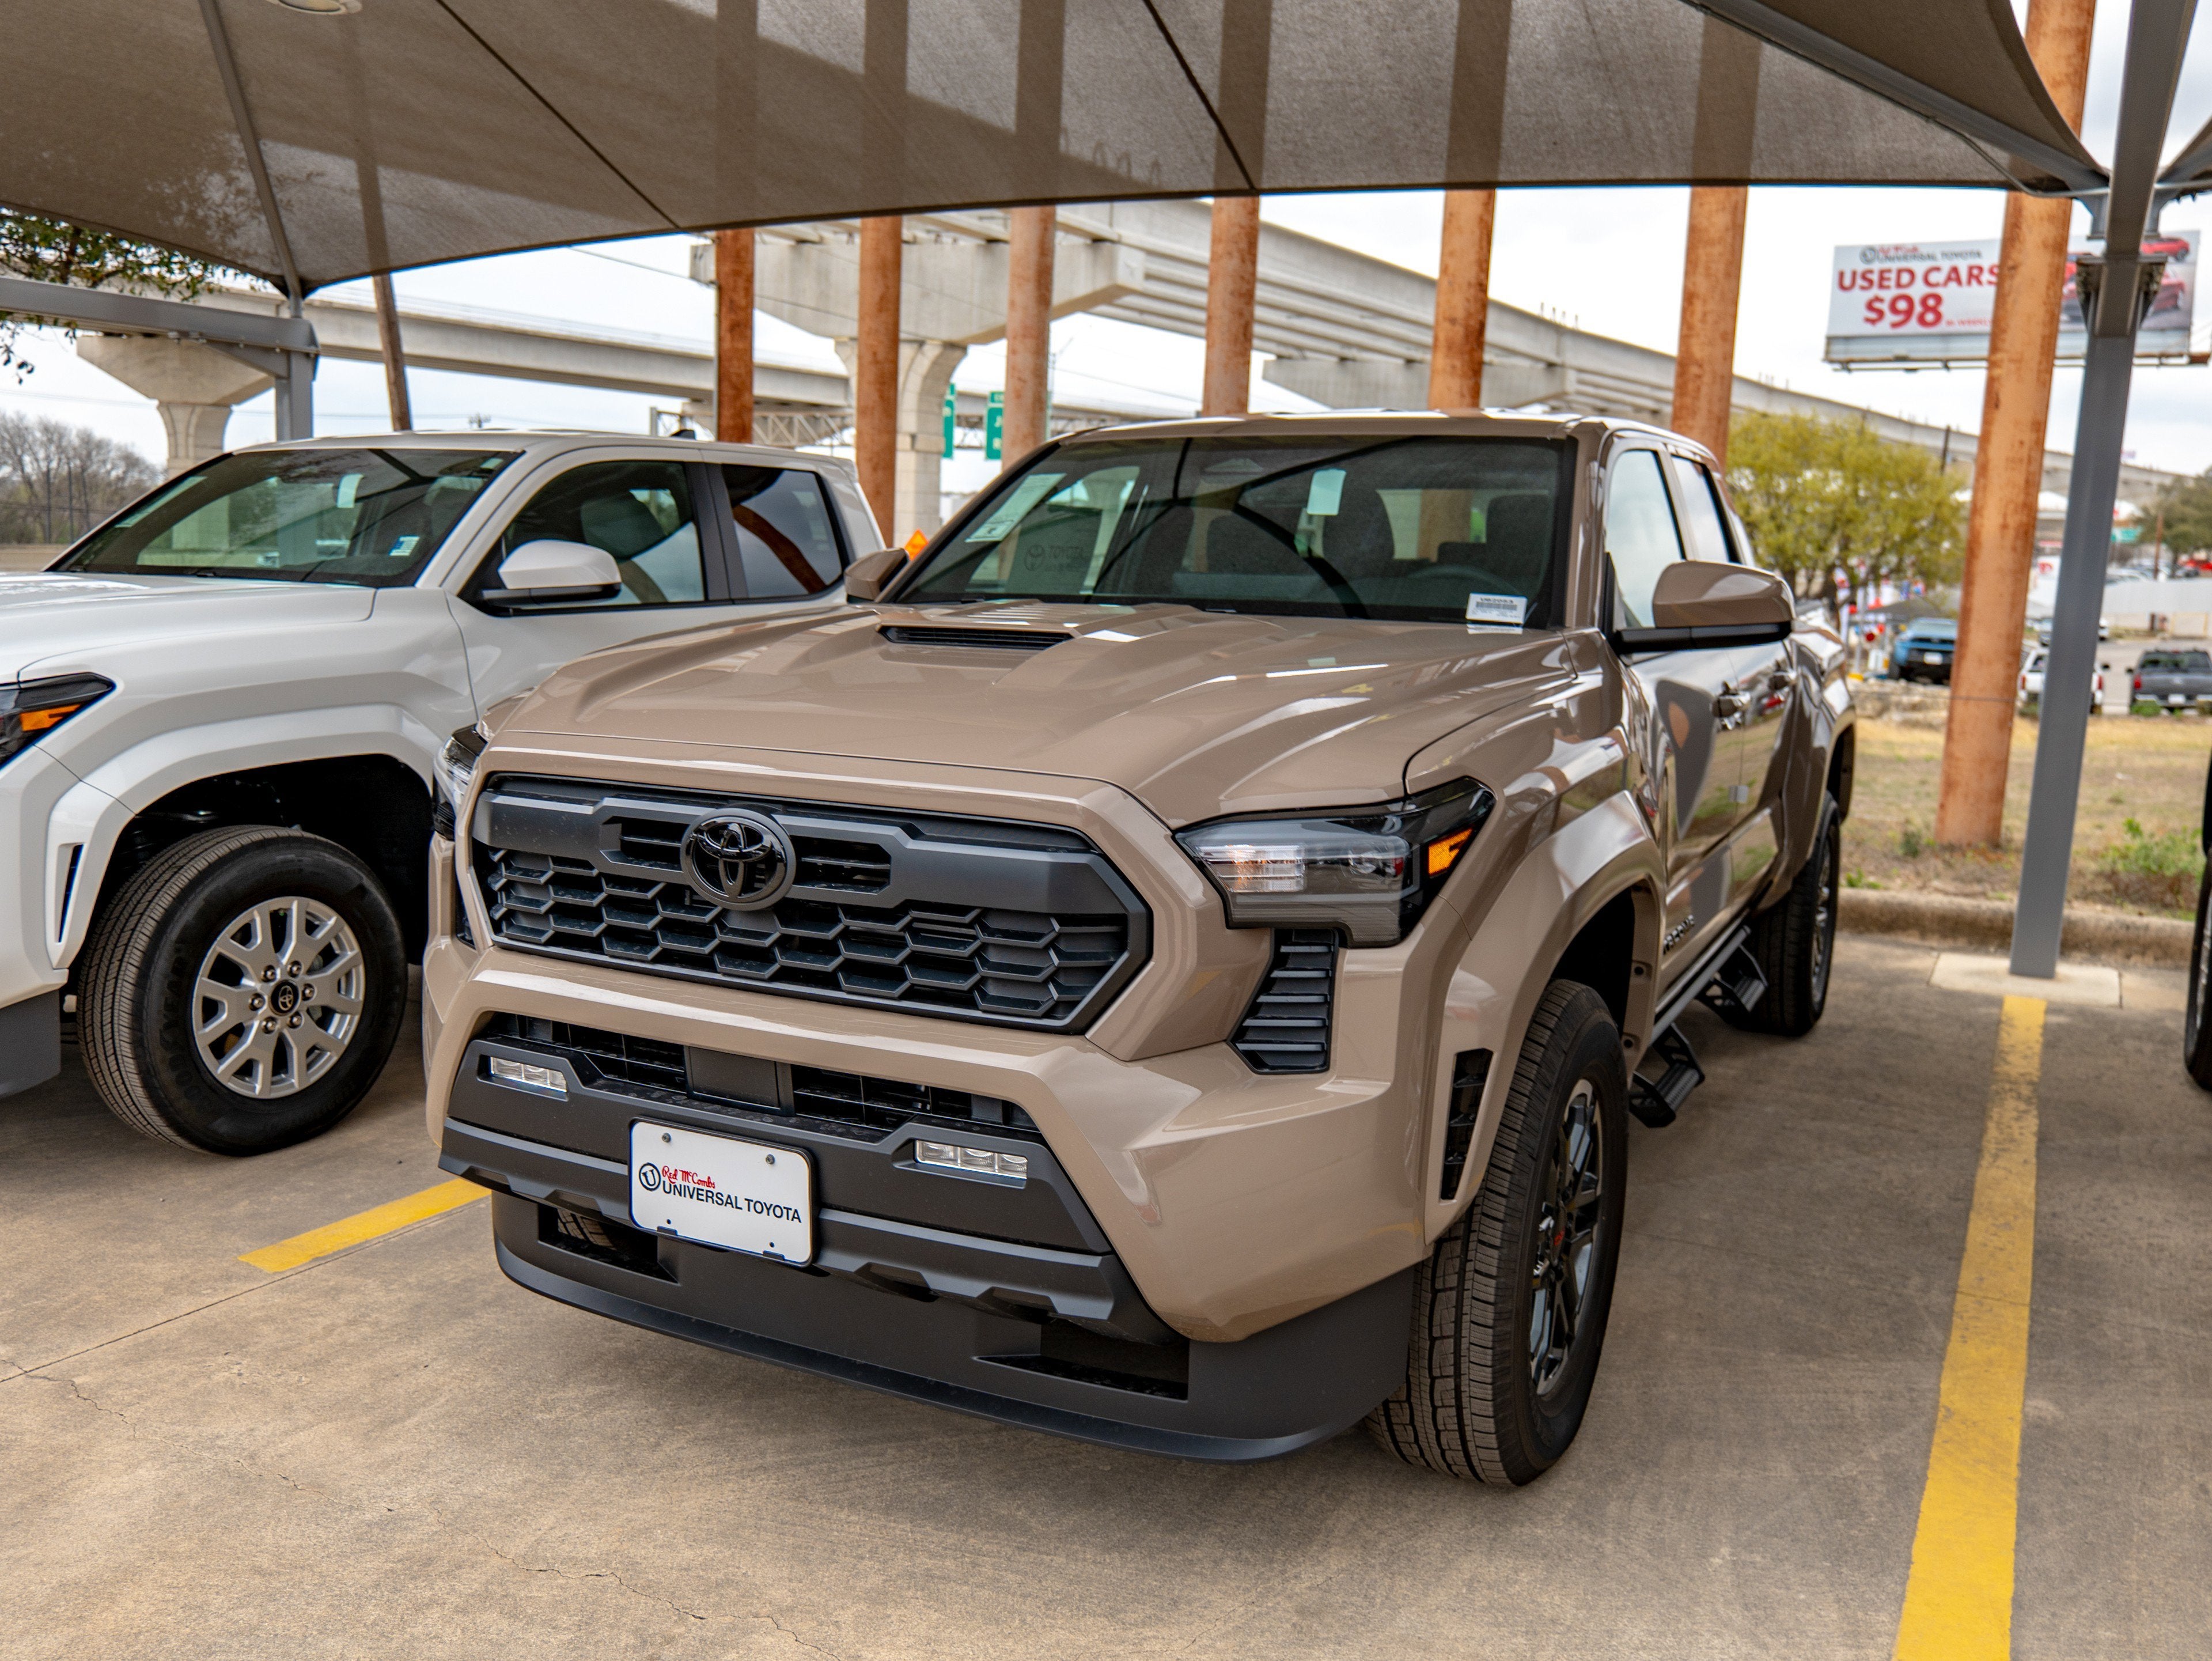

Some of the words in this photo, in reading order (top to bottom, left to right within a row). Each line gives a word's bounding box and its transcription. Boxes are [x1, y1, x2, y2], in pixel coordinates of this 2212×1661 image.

[1838, 267, 1915, 292] USED
[1922, 264, 1999, 287] CARS
[1863, 293, 1943, 328] $98
[662, 1166, 678, 1184] Red
[679, 1169, 715, 1189] McCombs
[662, 1180, 743, 1210] UNIVERSAL
[744, 1198, 801, 1223] TOYOTA
